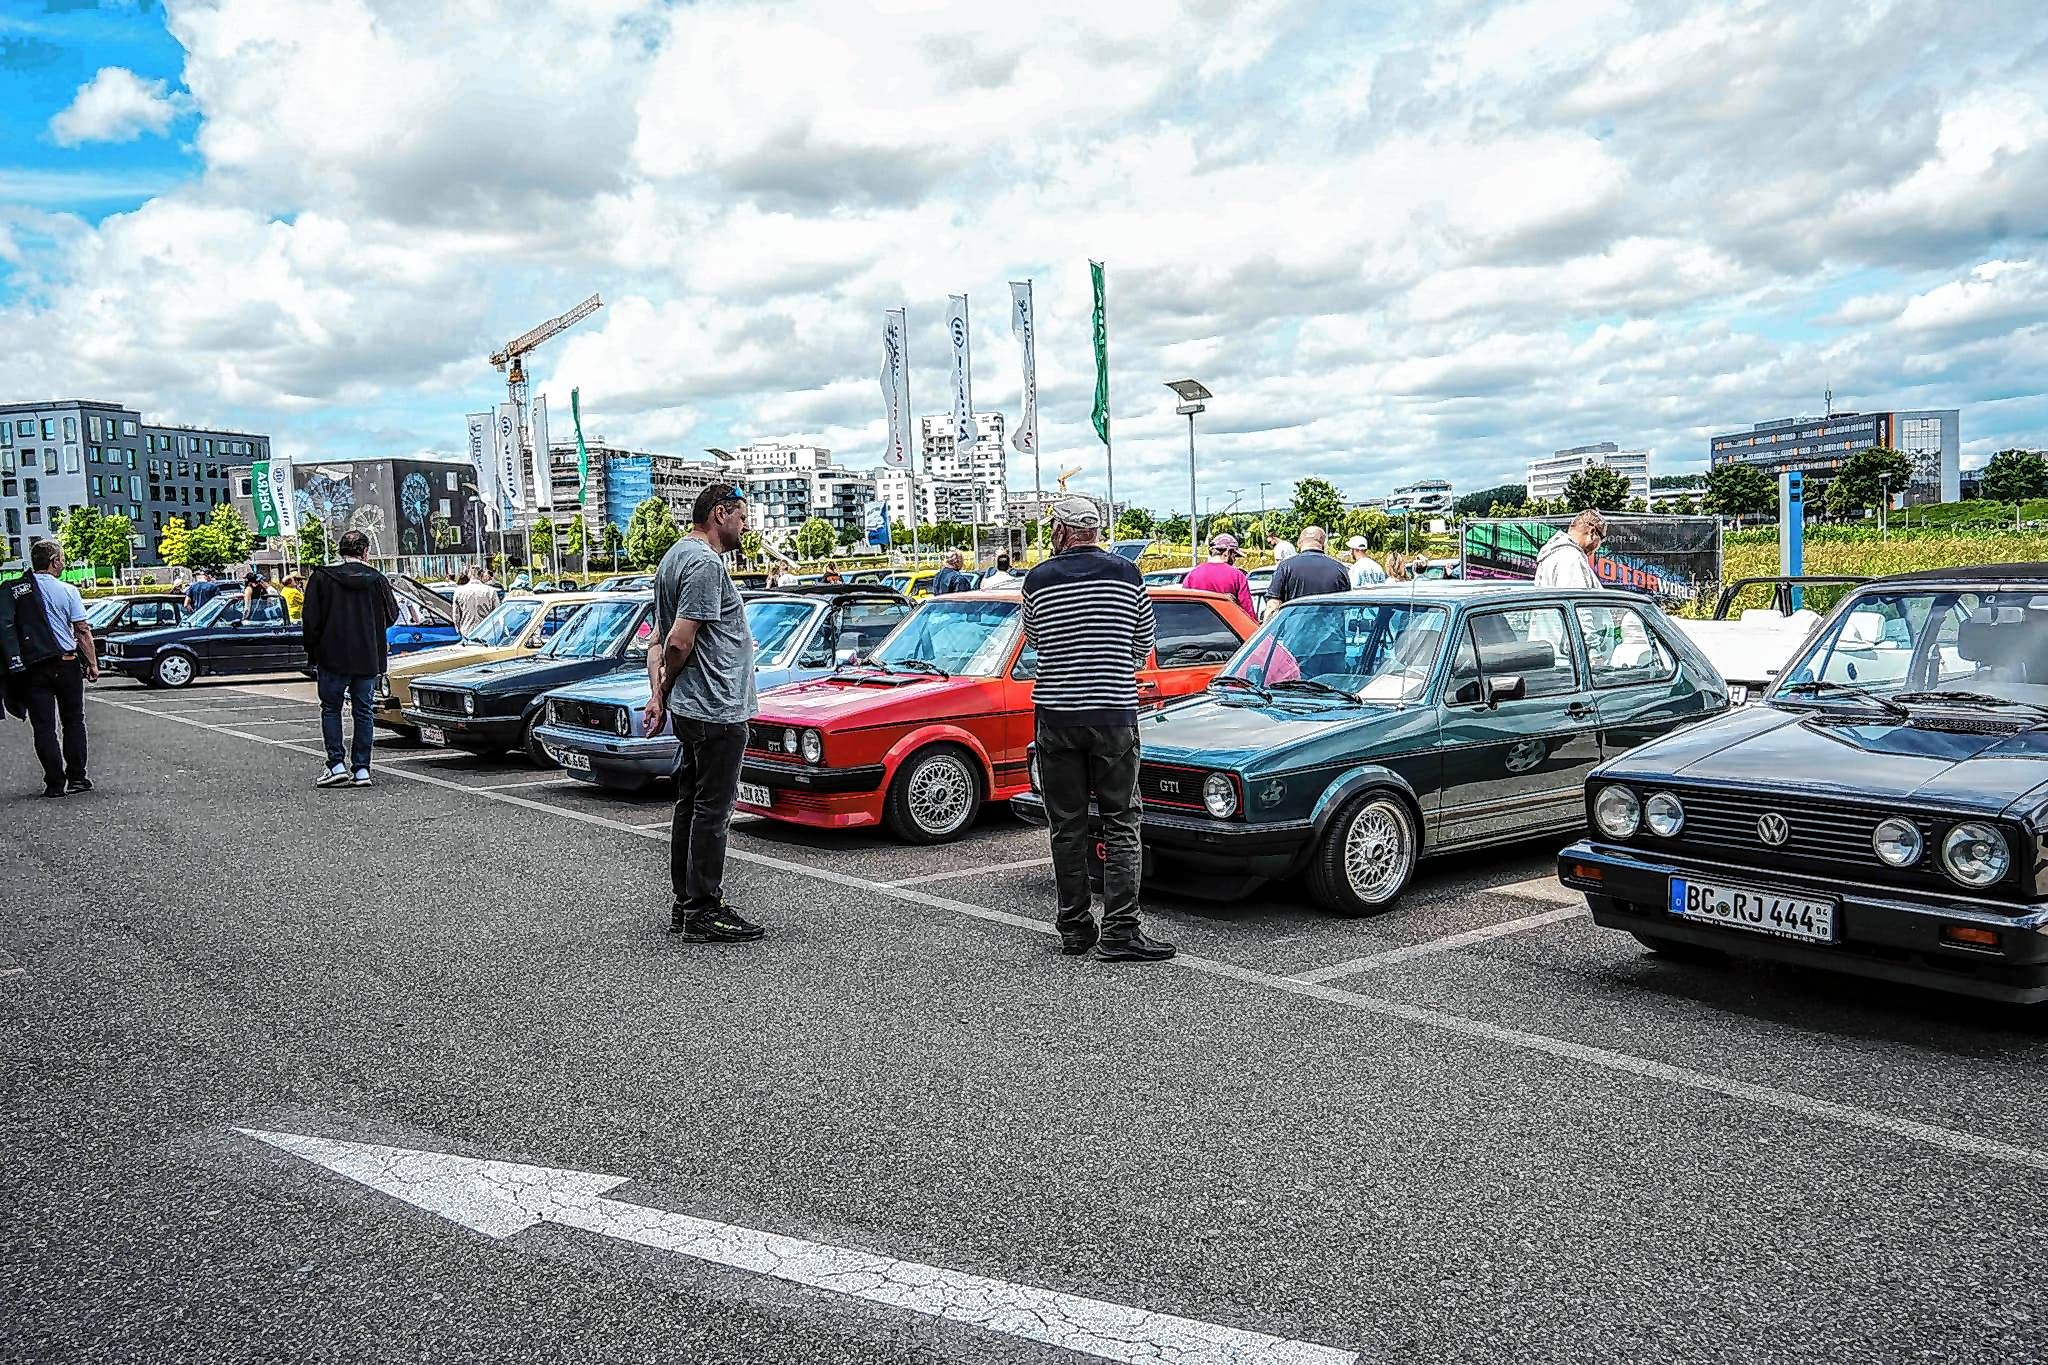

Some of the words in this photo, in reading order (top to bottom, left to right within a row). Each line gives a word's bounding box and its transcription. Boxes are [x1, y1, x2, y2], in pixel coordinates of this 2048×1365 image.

[1160, 780, 1180, 793] GTI
[1687, 885, 1715, 914] BC
[1733, 893, 1763, 923] RJ
[1770, 900, 1814, 932] 444
[1816, 925, 1828, 936] 10
